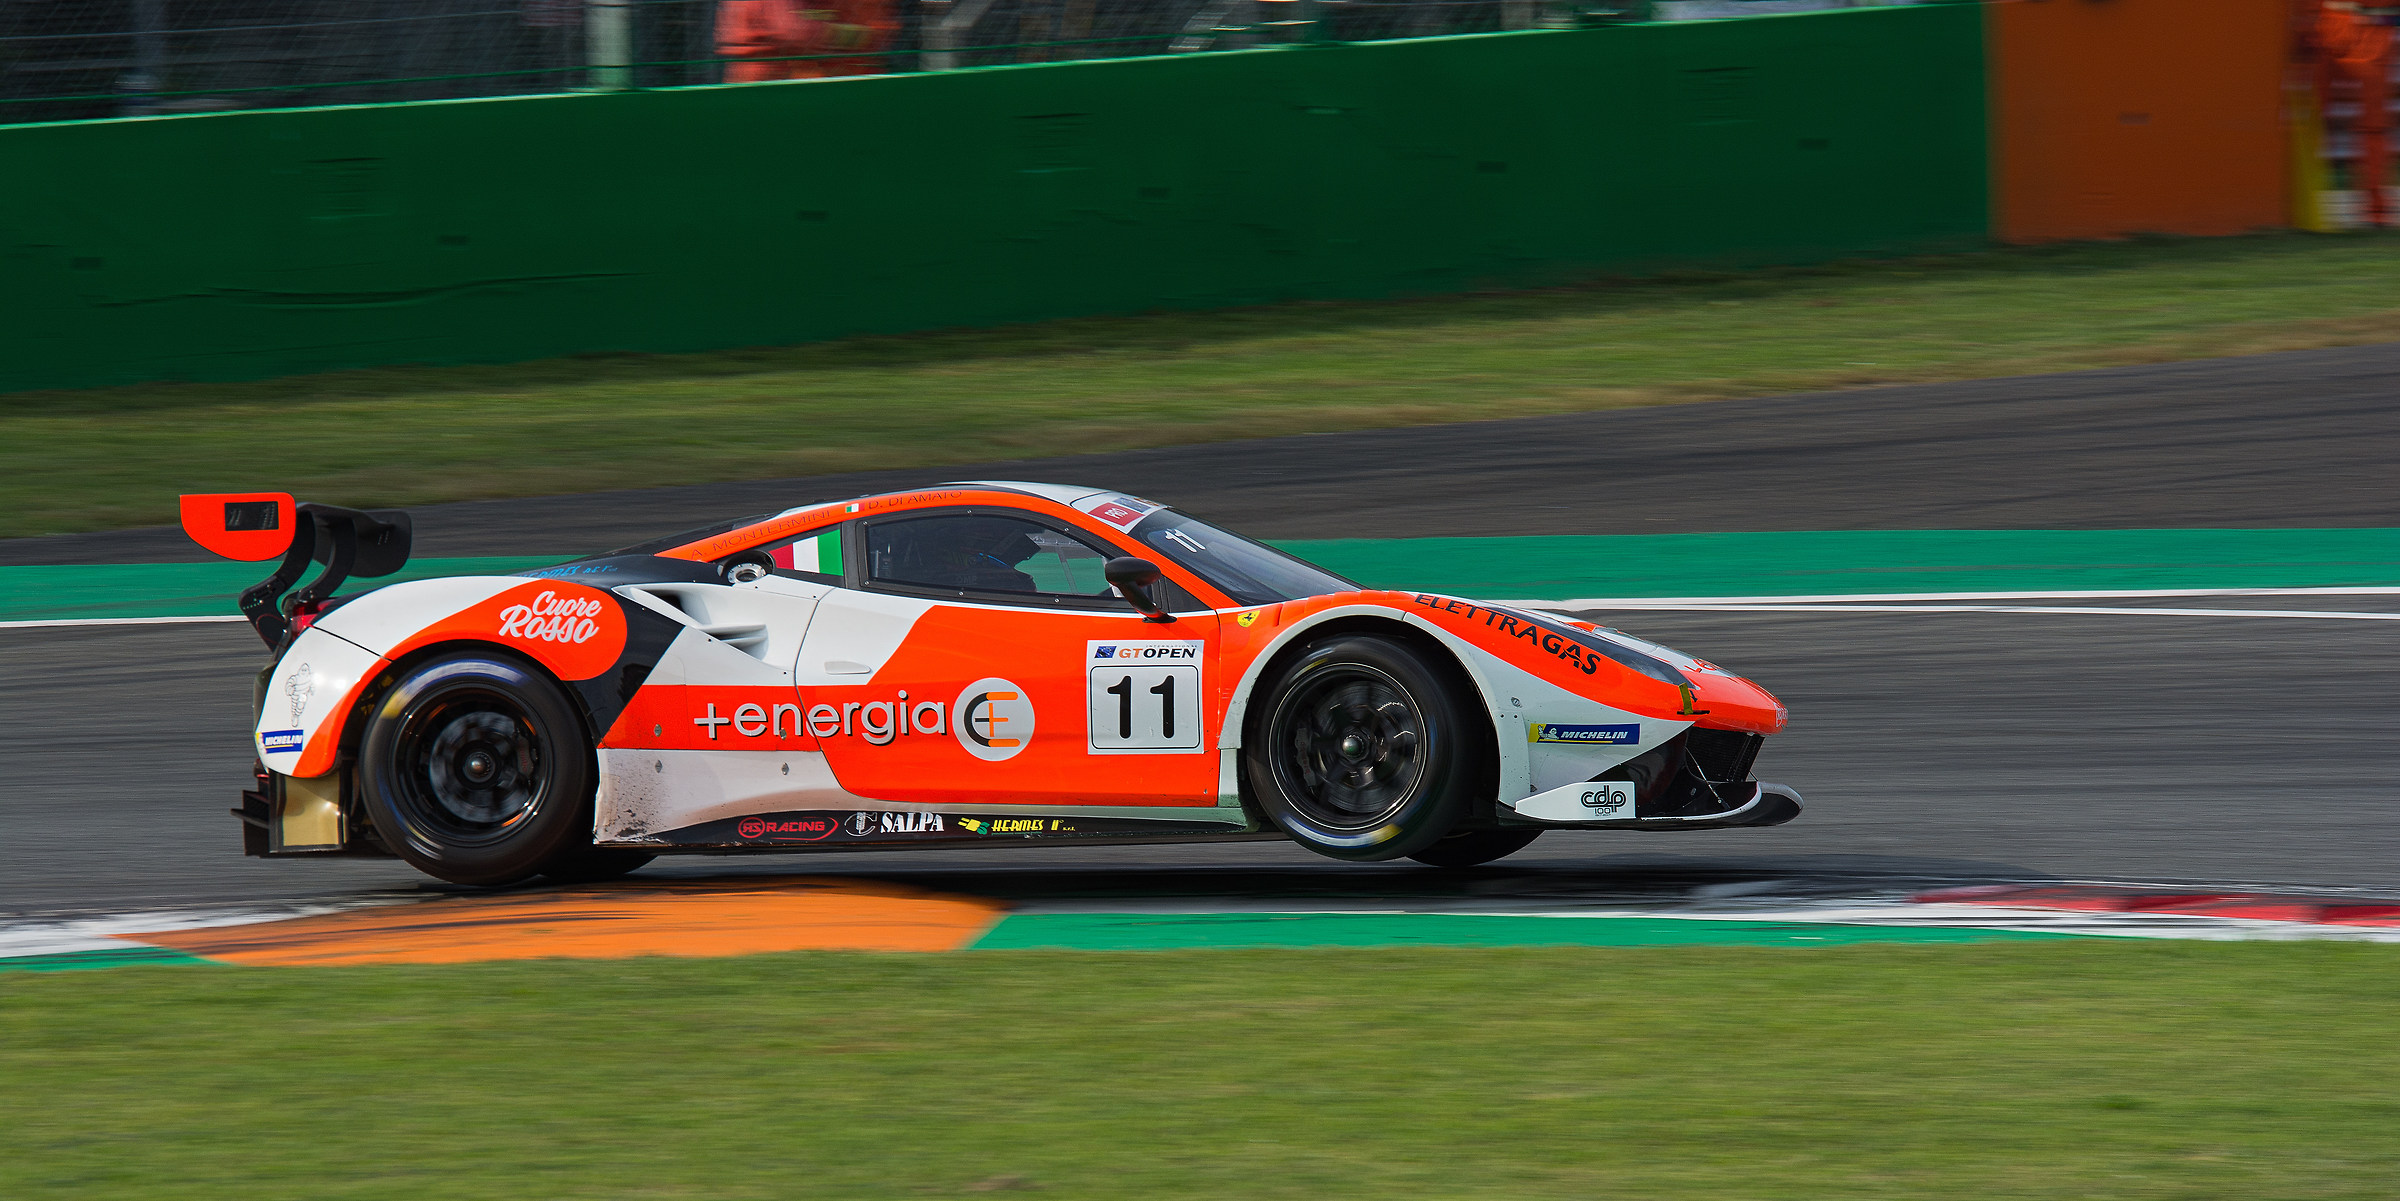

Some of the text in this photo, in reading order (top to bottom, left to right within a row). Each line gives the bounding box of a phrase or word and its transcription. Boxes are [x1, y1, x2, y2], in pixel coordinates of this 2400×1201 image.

[1165, 528, 1206, 553] 11
[532, 590, 602, 617] Cuore
[1414, 594, 1601, 675] ELETTRAGAS
[1107, 675, 1175, 739] 11
[265, 735, 303, 746] MICHELIN
[1560, 731, 1628, 739] MICHELIN
[1580, 785, 1627, 813] cdp
[766, 821, 825, 833] RACING
[880, 811, 945, 834] SALPA
[991, 819, 1044, 832] HERMES
